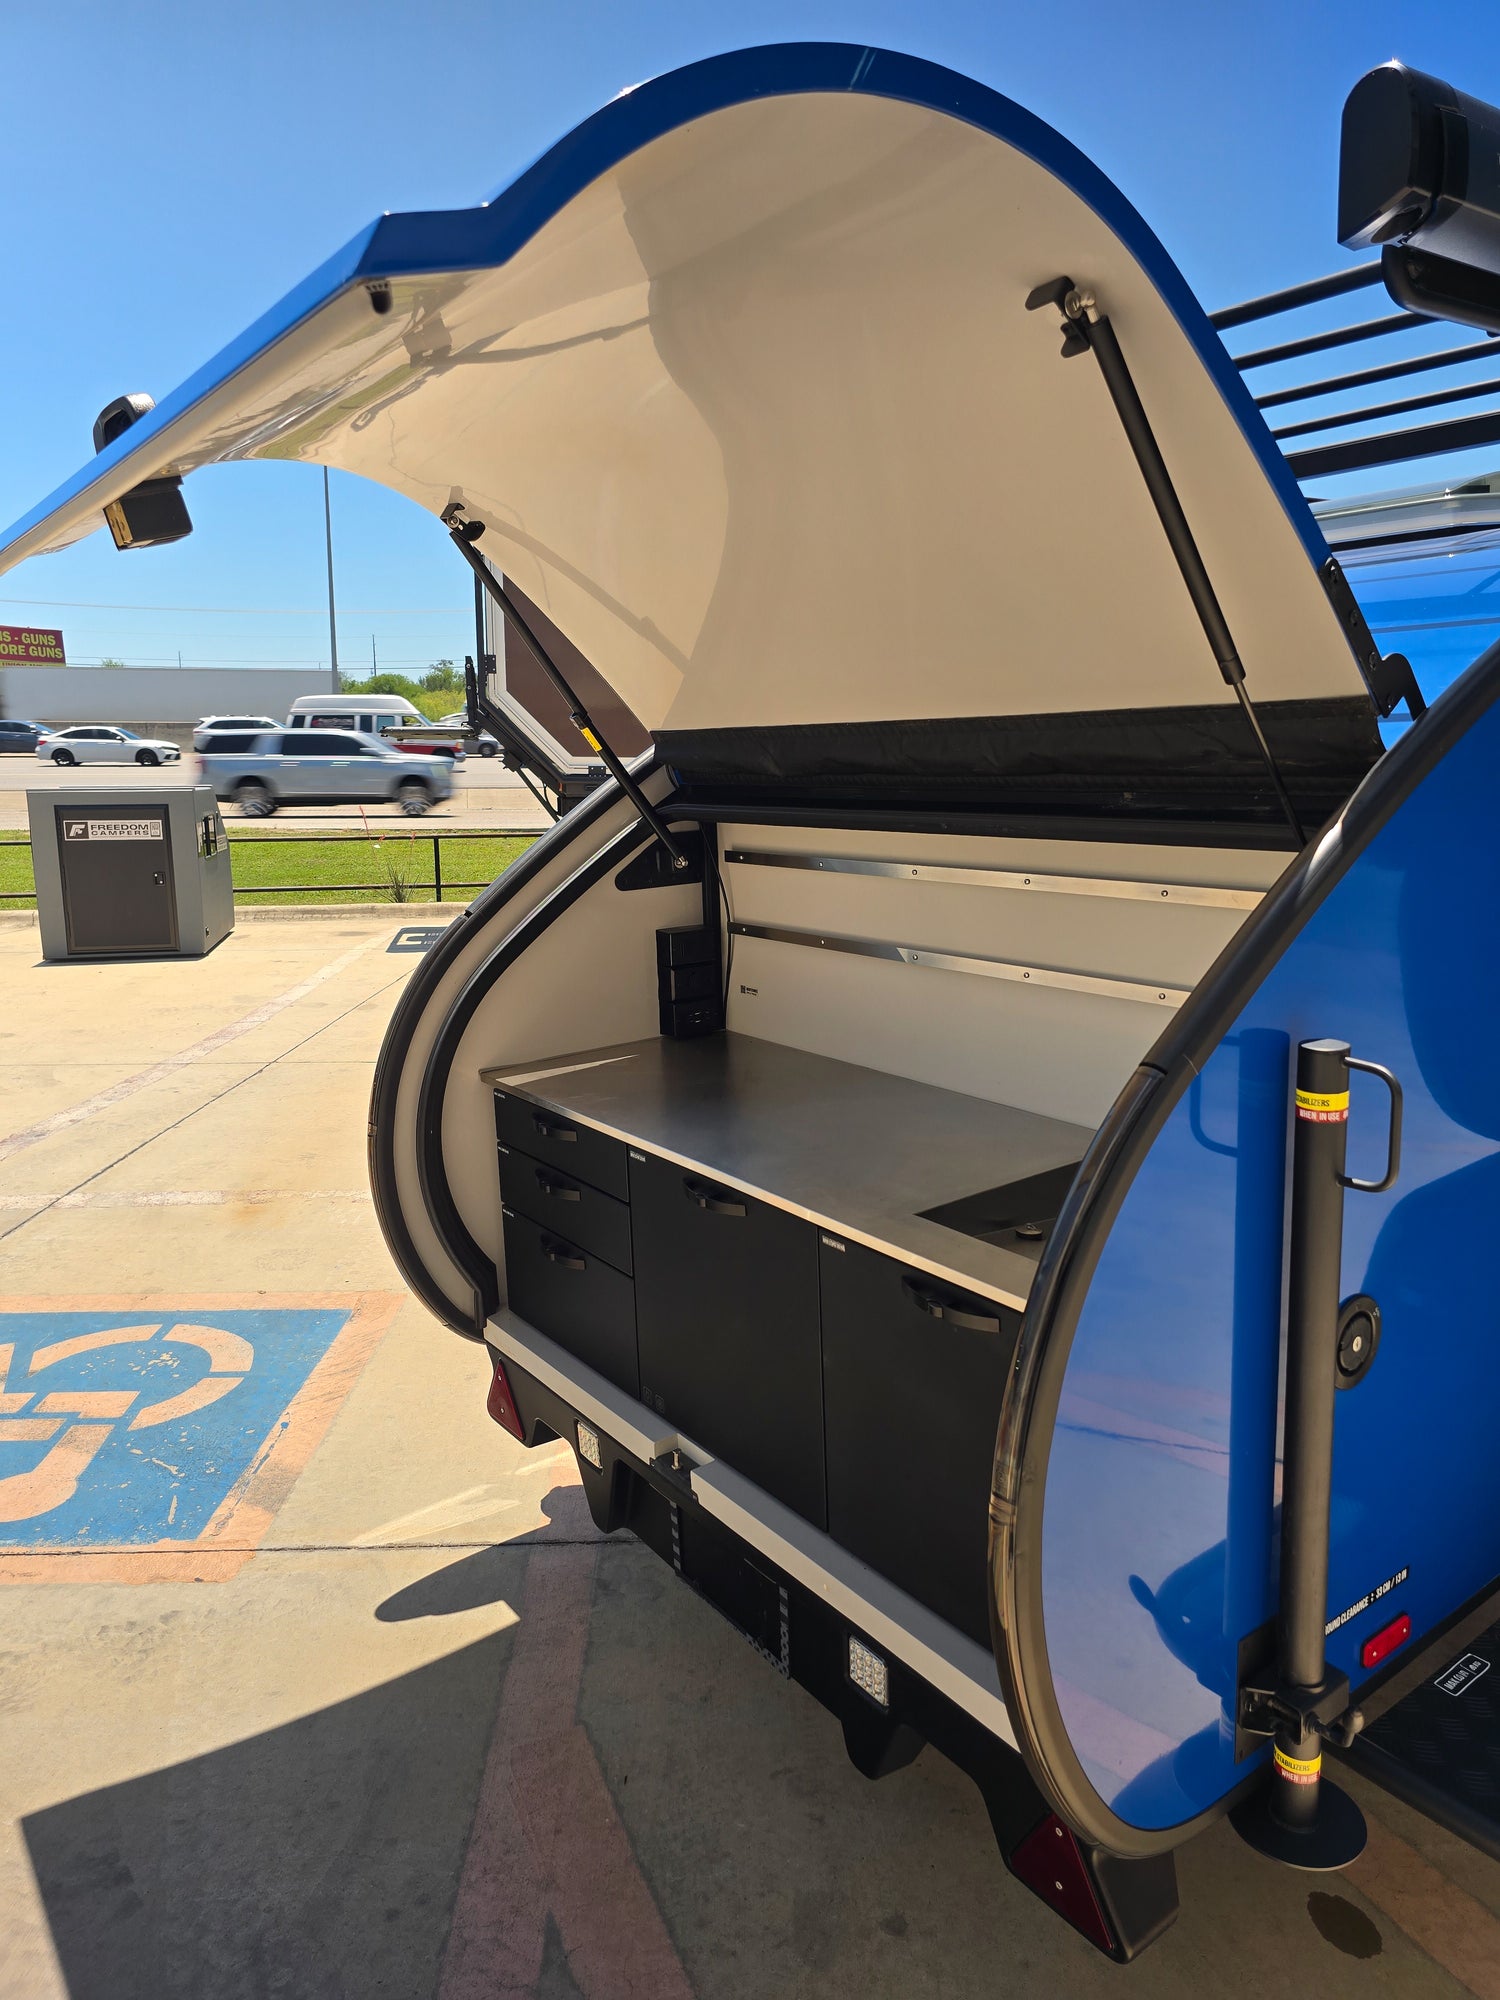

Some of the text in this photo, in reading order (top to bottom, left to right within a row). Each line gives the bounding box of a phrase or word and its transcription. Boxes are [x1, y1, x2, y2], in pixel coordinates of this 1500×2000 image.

[21, 632, 56, 646] GUNS
[29, 645, 63, 659] GUNS
[1299, 1108, 1317, 1120] WHEN
[1328, 1112, 1340, 1121] USE
[1341, 1596, 1369, 1624] CLEARANCE
[1277, 1753, 1310, 1772] STABILIZERS
[1281, 1768, 1299, 1783] WHEN
